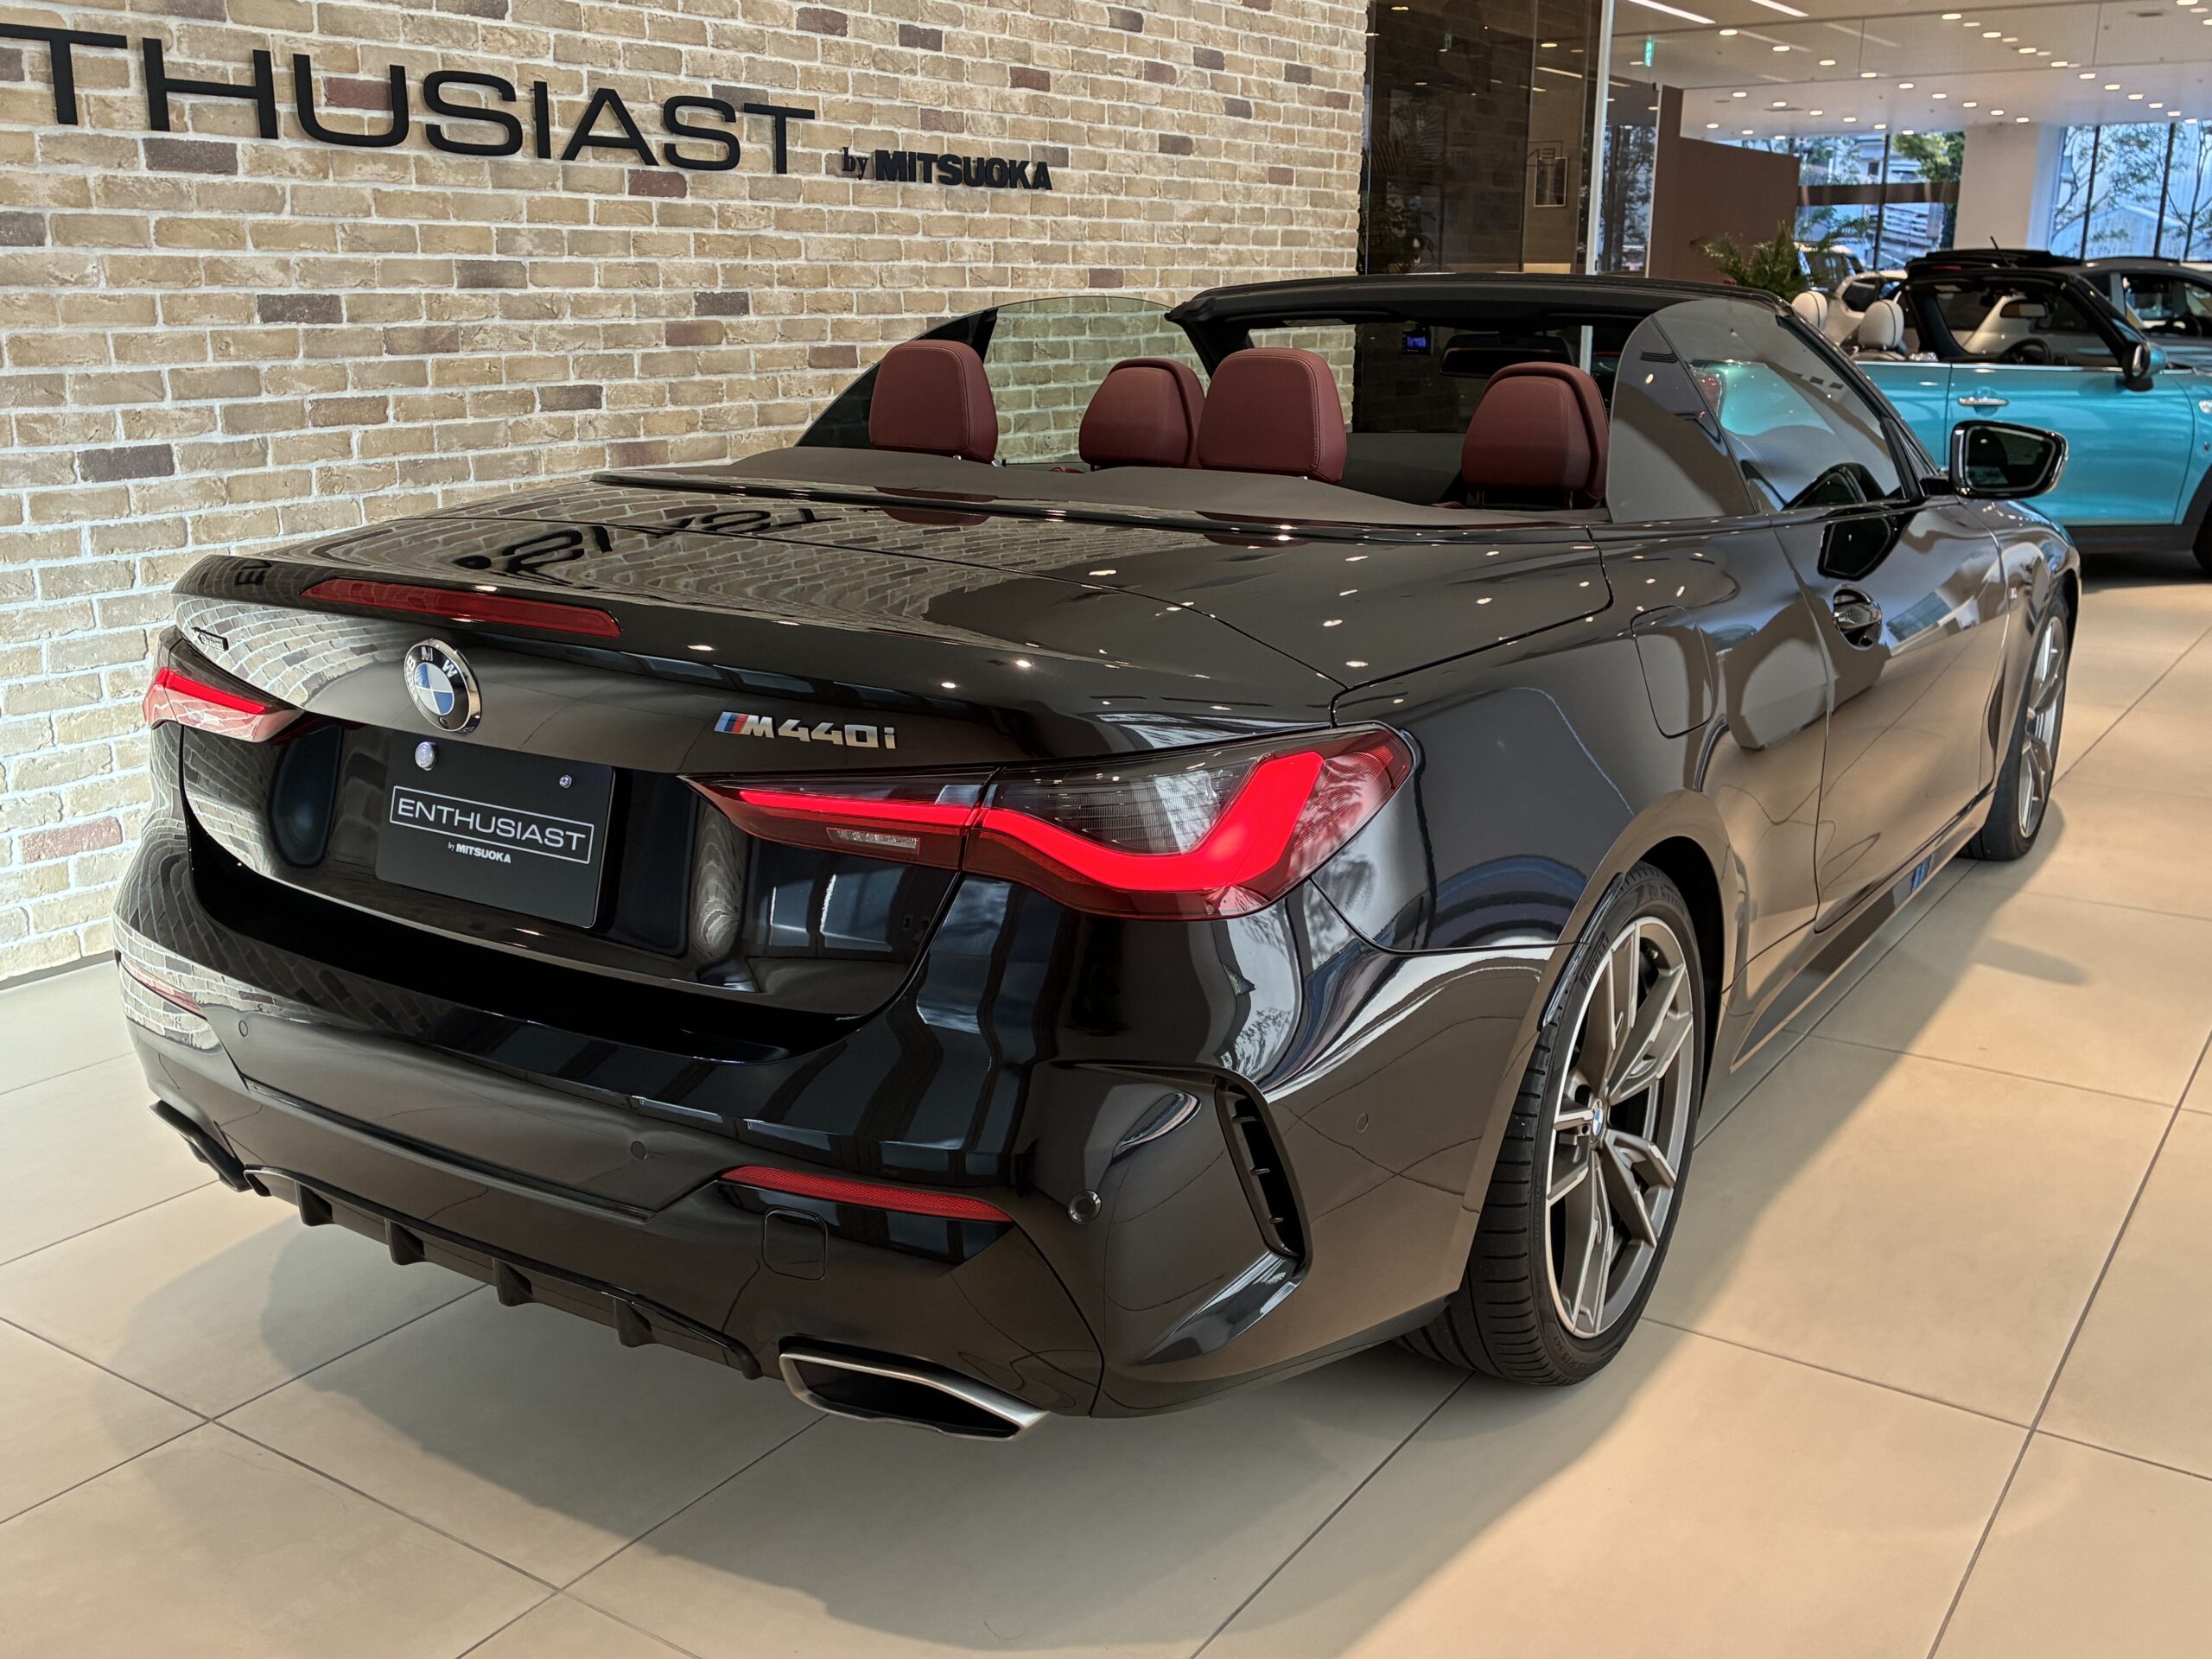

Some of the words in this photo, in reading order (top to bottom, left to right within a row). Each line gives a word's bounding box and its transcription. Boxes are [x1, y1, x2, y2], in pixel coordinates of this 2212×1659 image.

[0, 23, 815, 174] THUSIAST
[842, 147, 869, 181] by
[875, 149, 1052, 190] MITSUOKA
[406, 646, 458, 679] BMW
[741, 714, 896, 749] M440i
[397, 798, 586, 851] ENTHUSIAST
[448, 842, 456, 851] by
[456, 843, 512, 864] MITSUOKA
